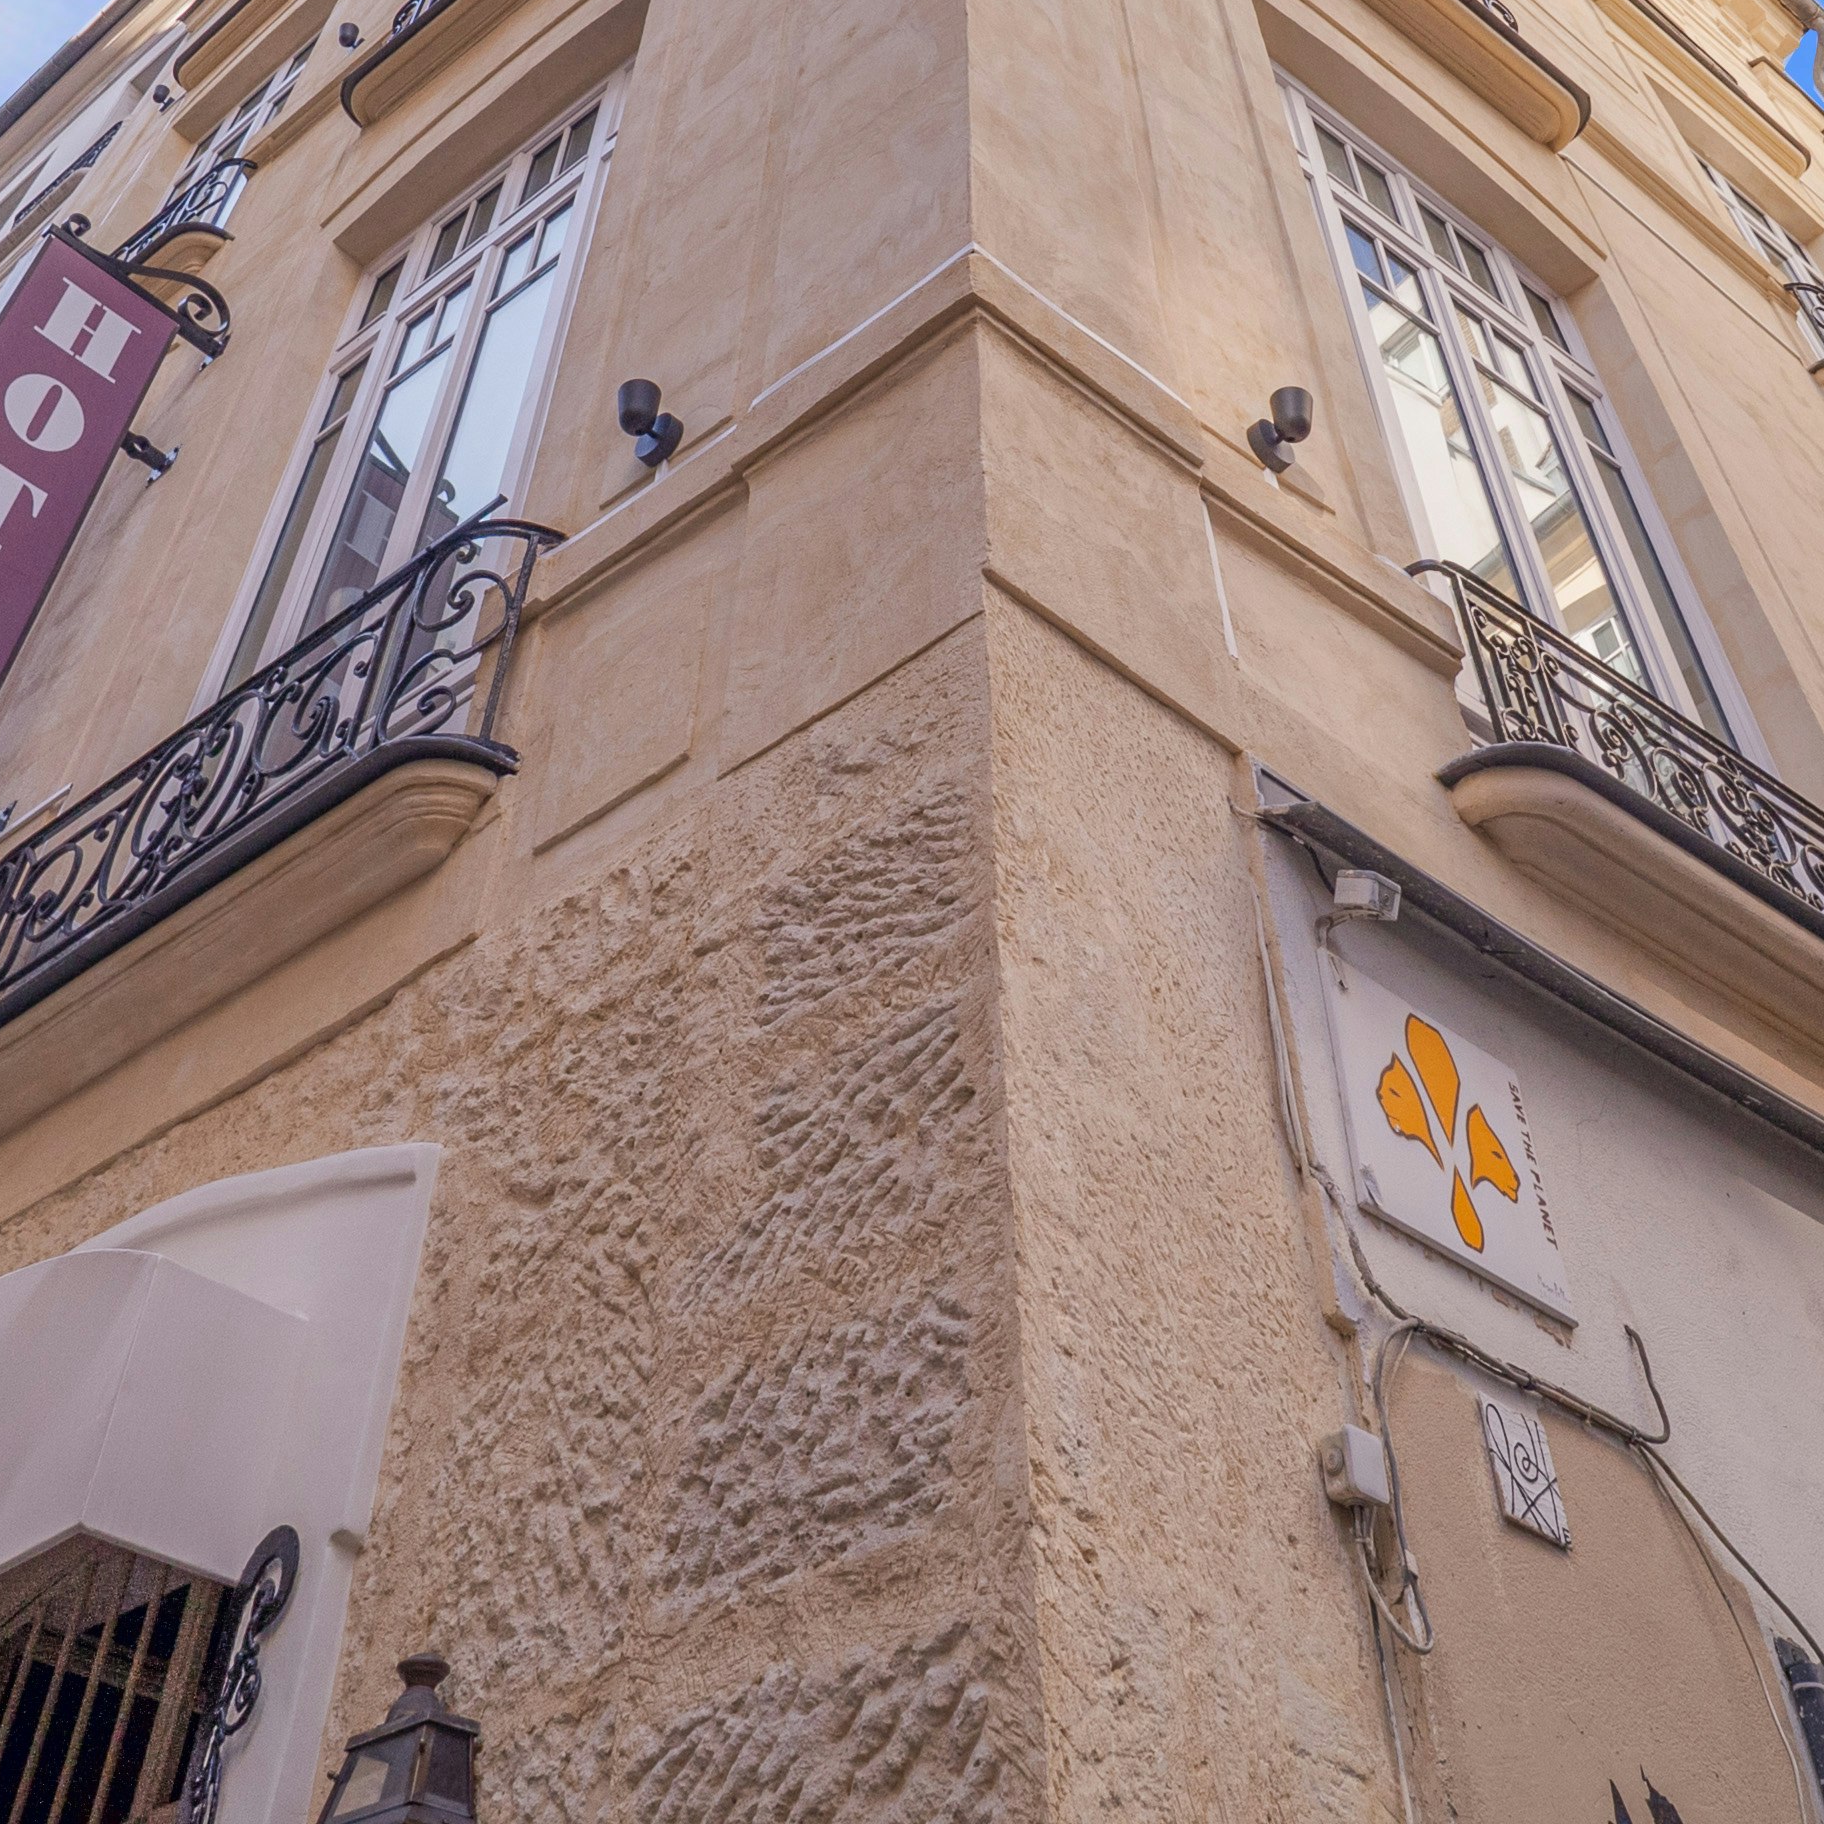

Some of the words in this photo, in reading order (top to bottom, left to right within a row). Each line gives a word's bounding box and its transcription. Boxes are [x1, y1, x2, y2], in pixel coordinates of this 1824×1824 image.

[1508, 1081, 1527, 1125] SAVE
[1521, 1130, 1537, 1165] THE
[1530, 1169, 1558, 1250] PLANET
